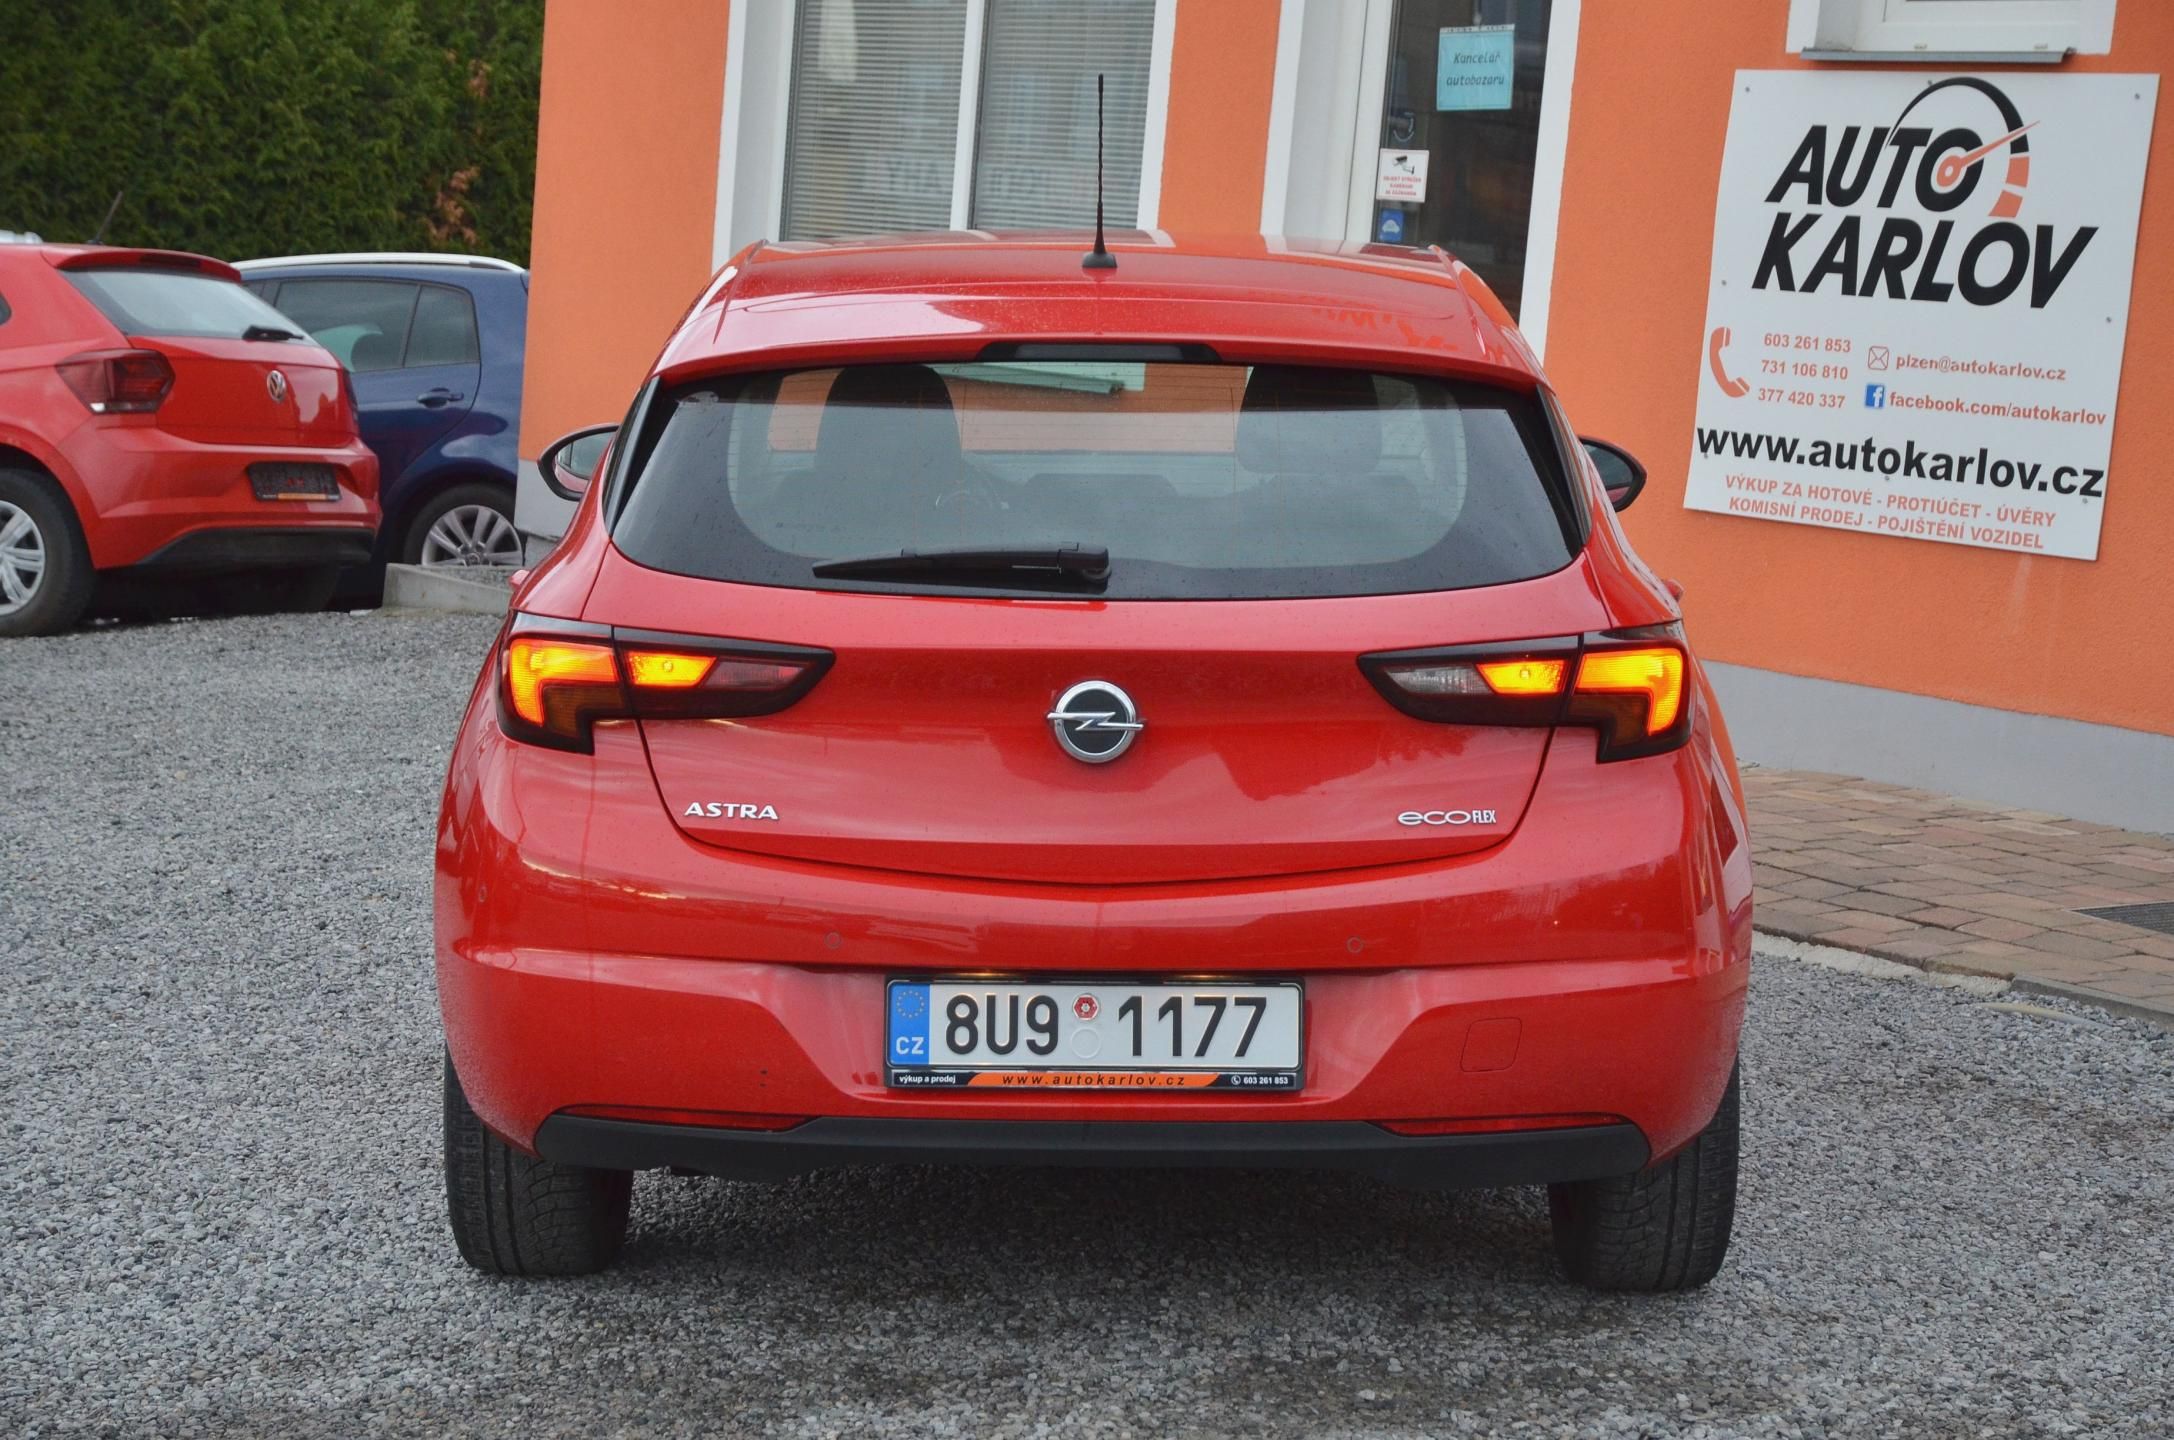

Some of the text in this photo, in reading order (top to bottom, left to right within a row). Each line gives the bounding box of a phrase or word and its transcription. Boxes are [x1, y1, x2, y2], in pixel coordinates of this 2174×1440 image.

[1764, 124, 1985, 212] AUTO
[1751, 211, 2099, 309] KARLOV
[1764, 332, 1851, 353] 603 261 853
[1761, 359, 1848, 381] 731 106 810
[1896, 354, 2066, 381] plzen@autokarlov.cz
[1758, 388, 1845, 409] 377 420 337
[1889, 391, 2107, 425] facebook.com/autokarlov
[1697, 427, 2105, 498] www.autokarlov.cz
[1726, 473, 1778, 494] VÝKUP
[1782, 482, 1802, 497] ZA
[1807, 485, 1873, 506] HOTOVÉ
[1887, 494, 1982, 519] PROTIÚČET
[1997, 504, 2056, 527] ÚVĚRY
[1729, 497, 1796, 518] KOMISNÍ
[1800, 506, 1863, 527] PRODEJ
[1877, 515, 1965, 540] POJIŠTĚNÍ
[1970, 527, 2045, 549] VOZIDEL
[684, 802, 779, 820] ASTRA
[946, 994, 1268, 1057] 8U9 1177
[896, 1035, 925, 1055] CZ
[899, 1074, 923, 1084] výkup
[931, 1074, 956, 1084] prodej
[1001, 1074, 1186, 1086] www.autokarlov.cz
[1243, 1077, 1288, 1085] 603 261 853
